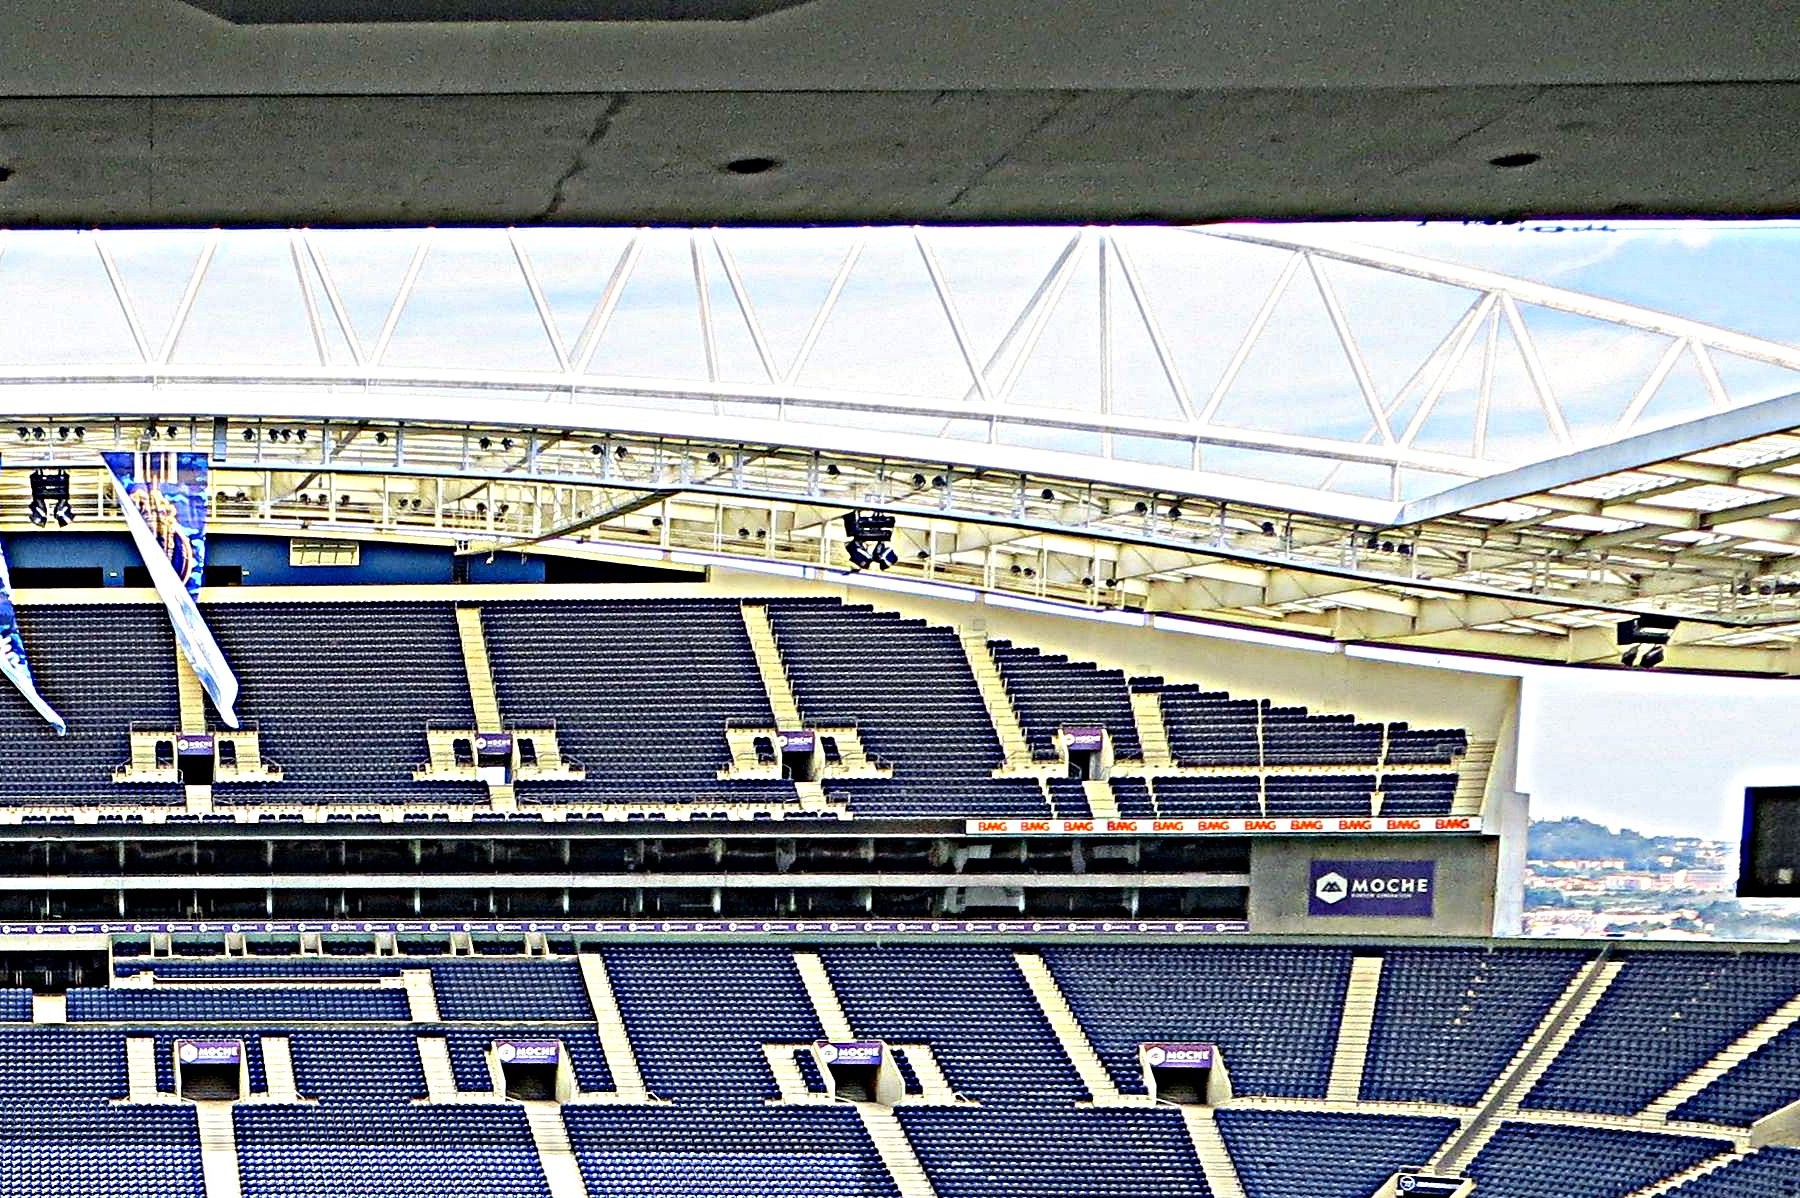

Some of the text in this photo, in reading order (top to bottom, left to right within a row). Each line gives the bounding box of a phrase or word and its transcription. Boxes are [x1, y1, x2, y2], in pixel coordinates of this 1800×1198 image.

[1352, 878, 1428, 893] MOCHE
[517, 1046, 556, 1056] MOCHE
[839, 1047, 880, 1056] MOCHE
[1167, 1050, 1209, 1060] MOCHE
